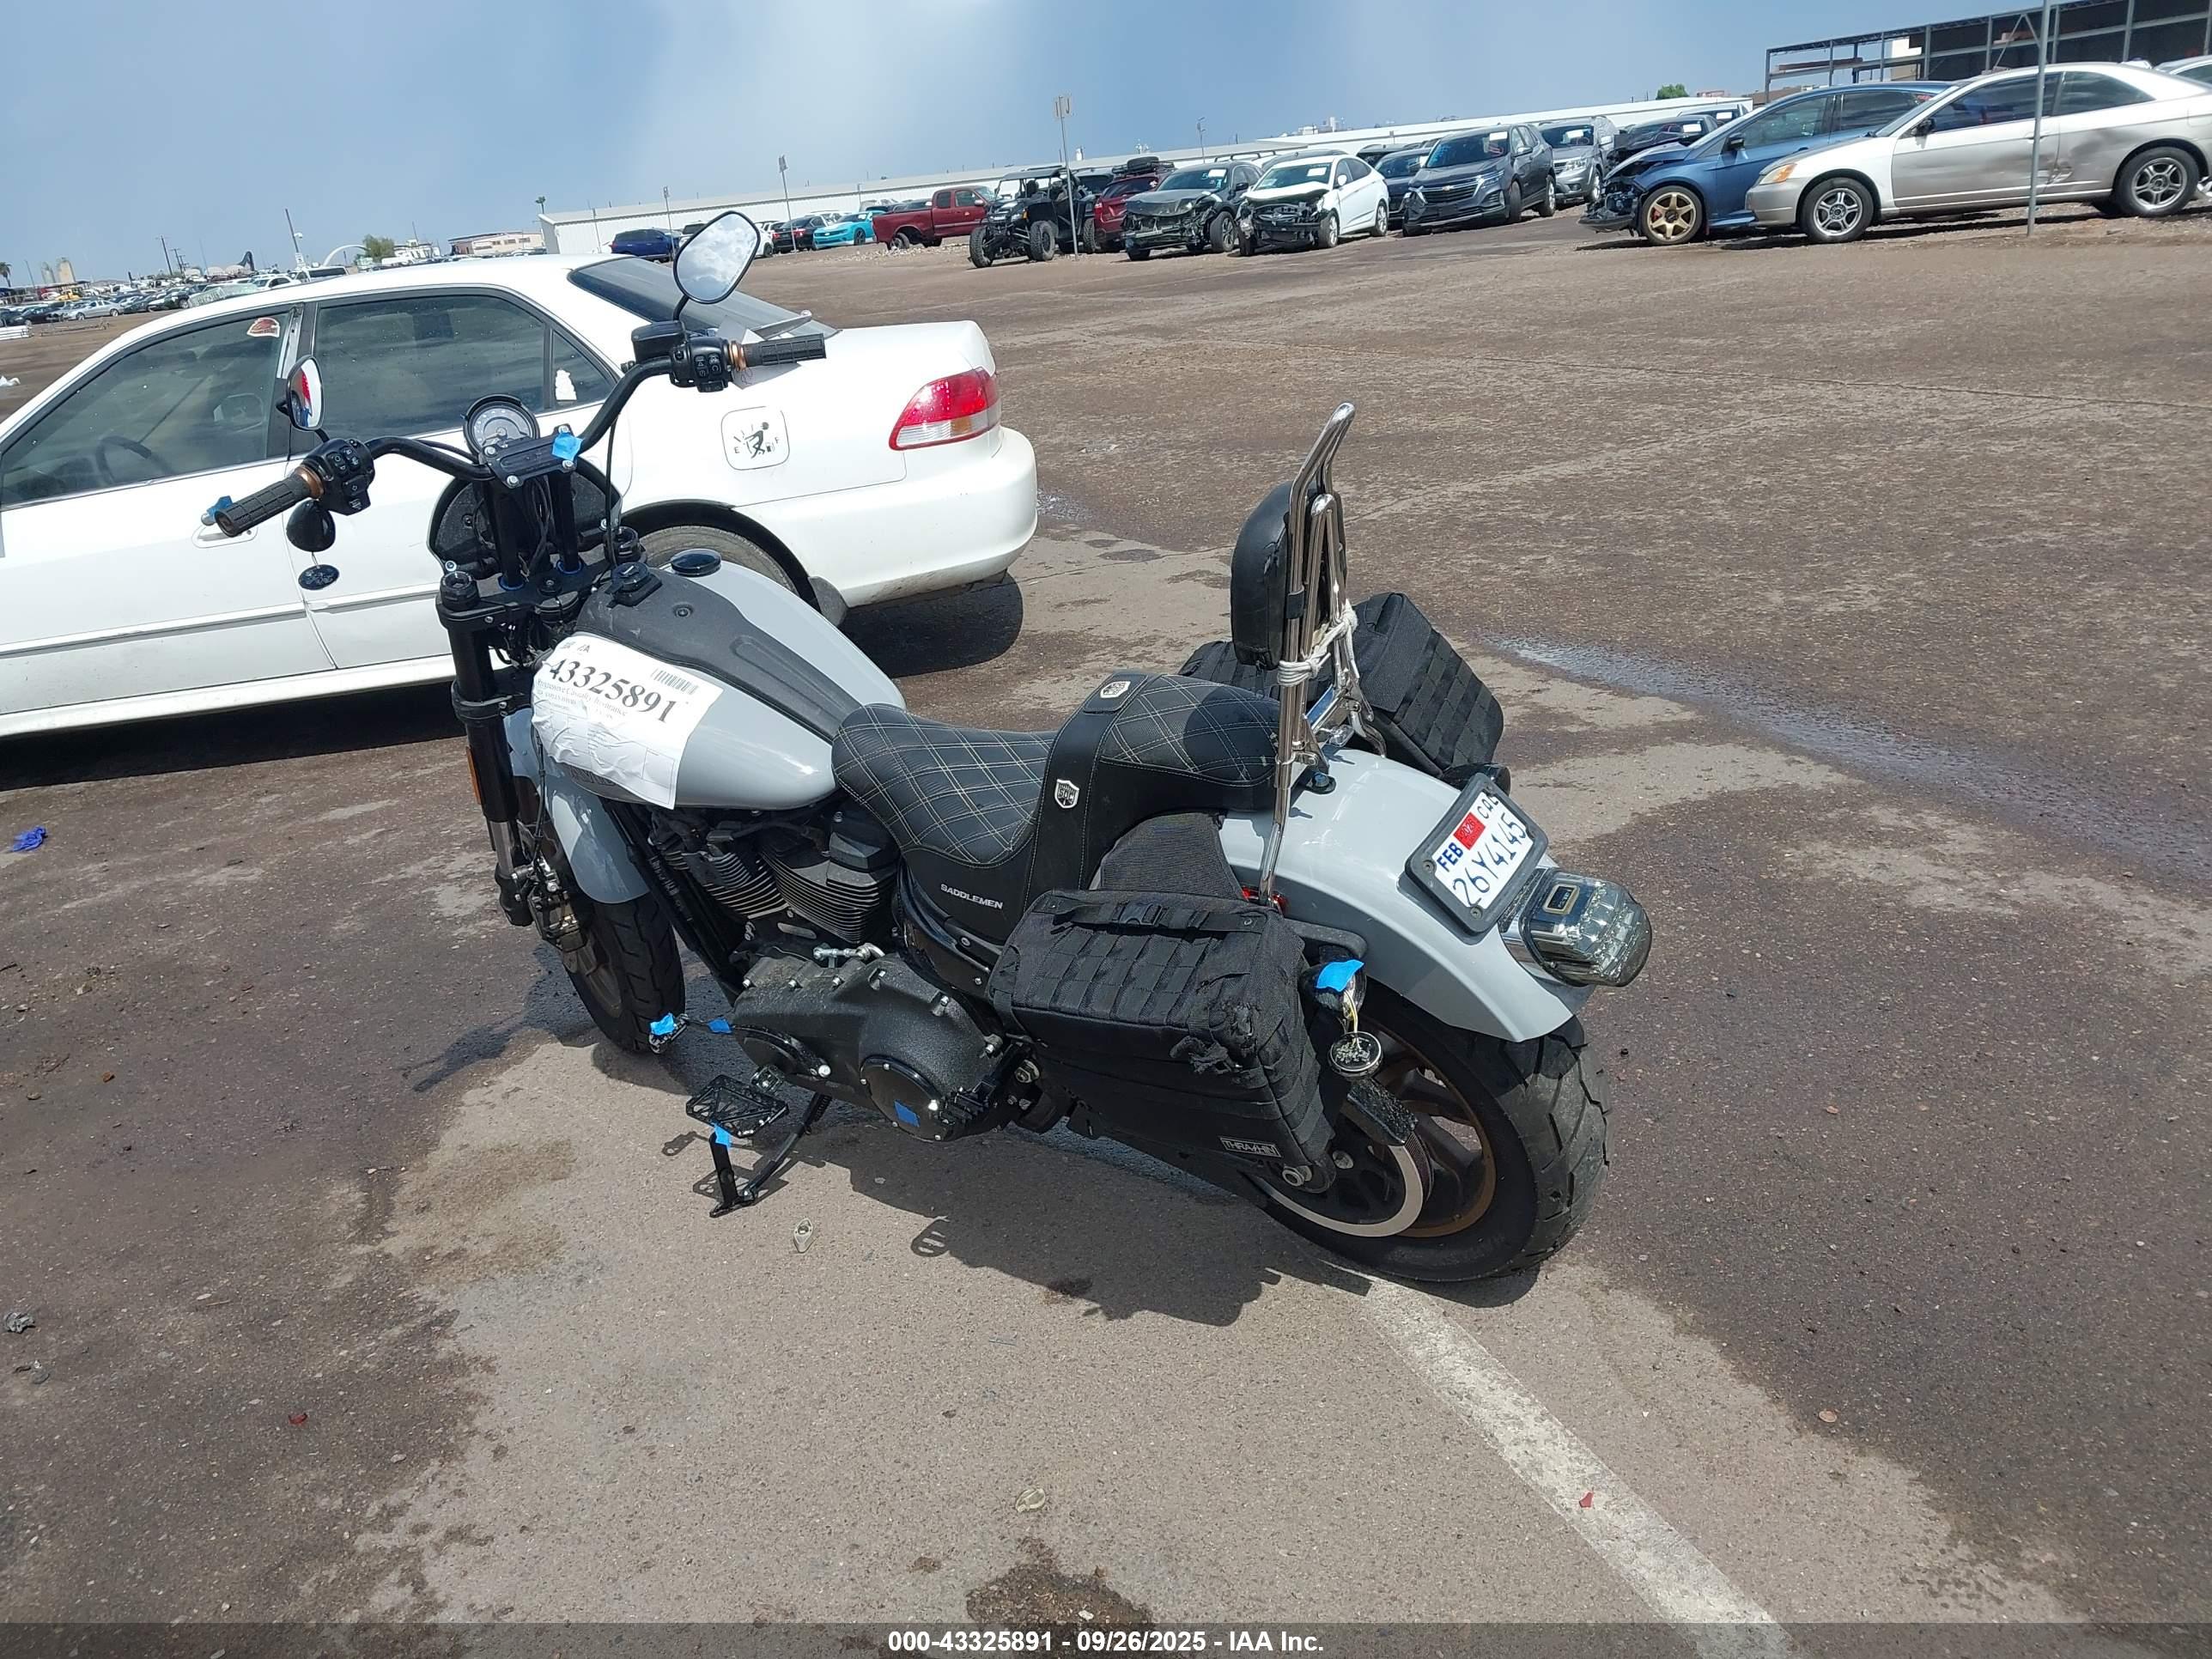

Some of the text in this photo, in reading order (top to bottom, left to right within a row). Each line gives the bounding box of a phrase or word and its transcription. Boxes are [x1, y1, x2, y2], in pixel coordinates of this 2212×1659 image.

[550, 659, 677, 723] 43325891
[1437, 842, 1465, 872] FEB
[1461, 818, 1477, 838] 2026
[1452, 812, 1528, 907] 26Y4145
[940, 883, 1004, 910] SADDLEMEN
